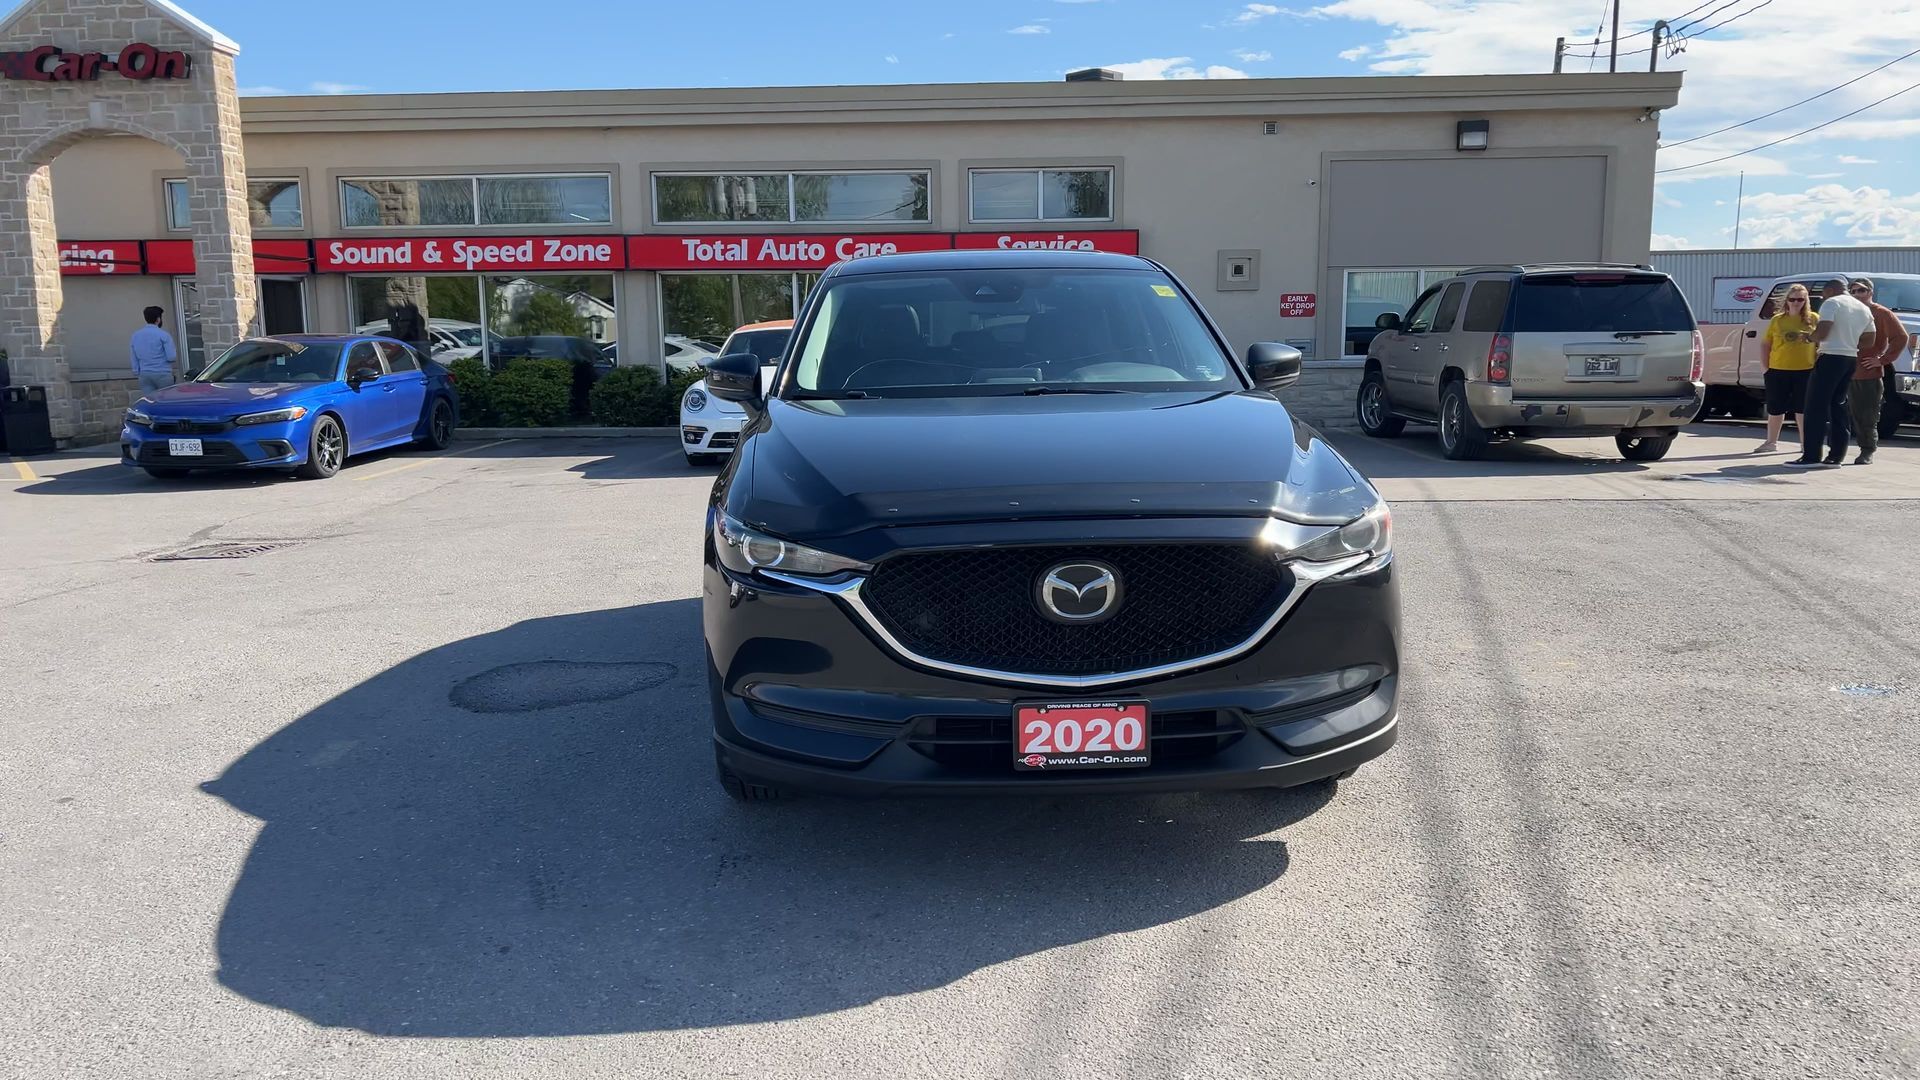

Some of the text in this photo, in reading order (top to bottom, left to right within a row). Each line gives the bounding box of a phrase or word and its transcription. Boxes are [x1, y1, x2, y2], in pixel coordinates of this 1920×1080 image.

[30, 43, 190, 81] Car-On
[330, 240, 611, 270] Sound & Speed Zone
[682, 238, 897, 261] Total Auto Care
[1024, 717, 1142, 753] 2020
[1048, 755, 1147, 765] www.Car-On.com
